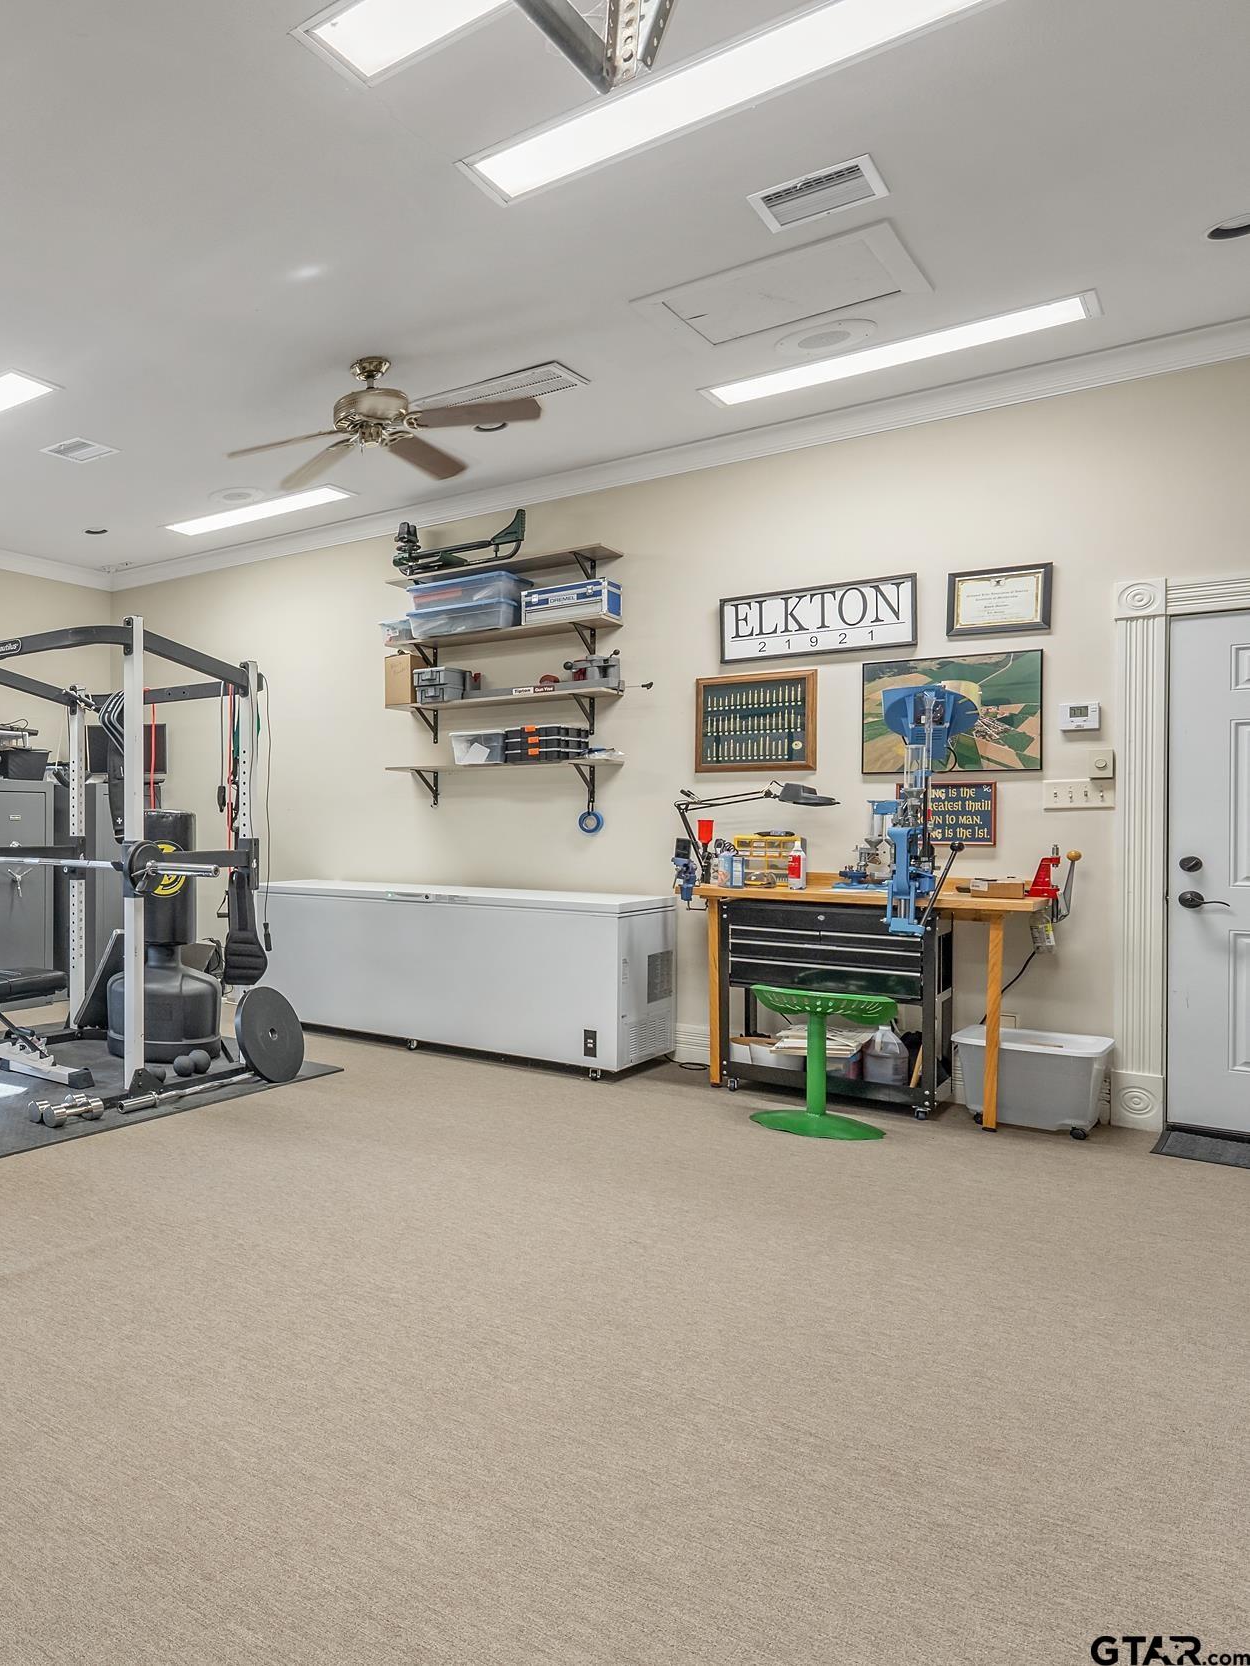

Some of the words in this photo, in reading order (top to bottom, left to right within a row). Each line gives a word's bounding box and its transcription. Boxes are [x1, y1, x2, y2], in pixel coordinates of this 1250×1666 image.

[730, 582, 906, 639] ELKTON
[948, 786, 957, 797] is
[960, 786, 976, 799] the
[946, 814, 956, 824] to
[945, 826, 953, 838] is
[956, 827, 972, 839] the
